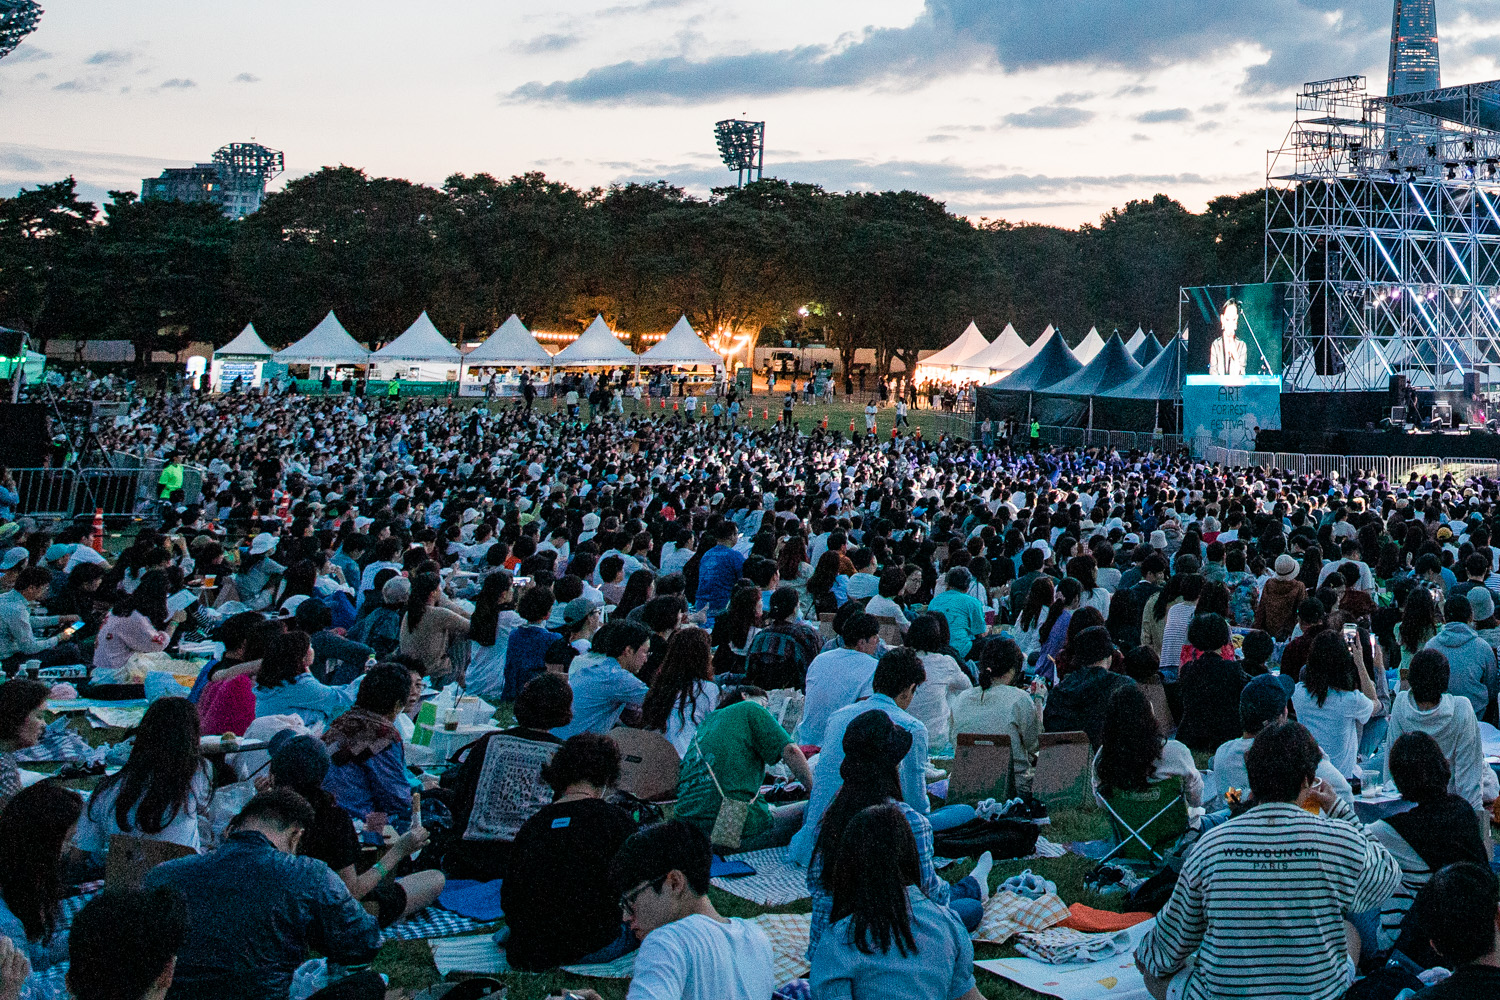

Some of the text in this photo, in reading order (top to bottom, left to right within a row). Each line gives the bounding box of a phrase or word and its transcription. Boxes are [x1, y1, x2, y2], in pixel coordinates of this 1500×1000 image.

[1218, 386, 1241, 401] ART
[1210, 419, 1249, 430] FESTIVAL
[1223, 847, 1319, 858] WOOYOUNGMI
[1253, 862, 1289, 871] PARIS
